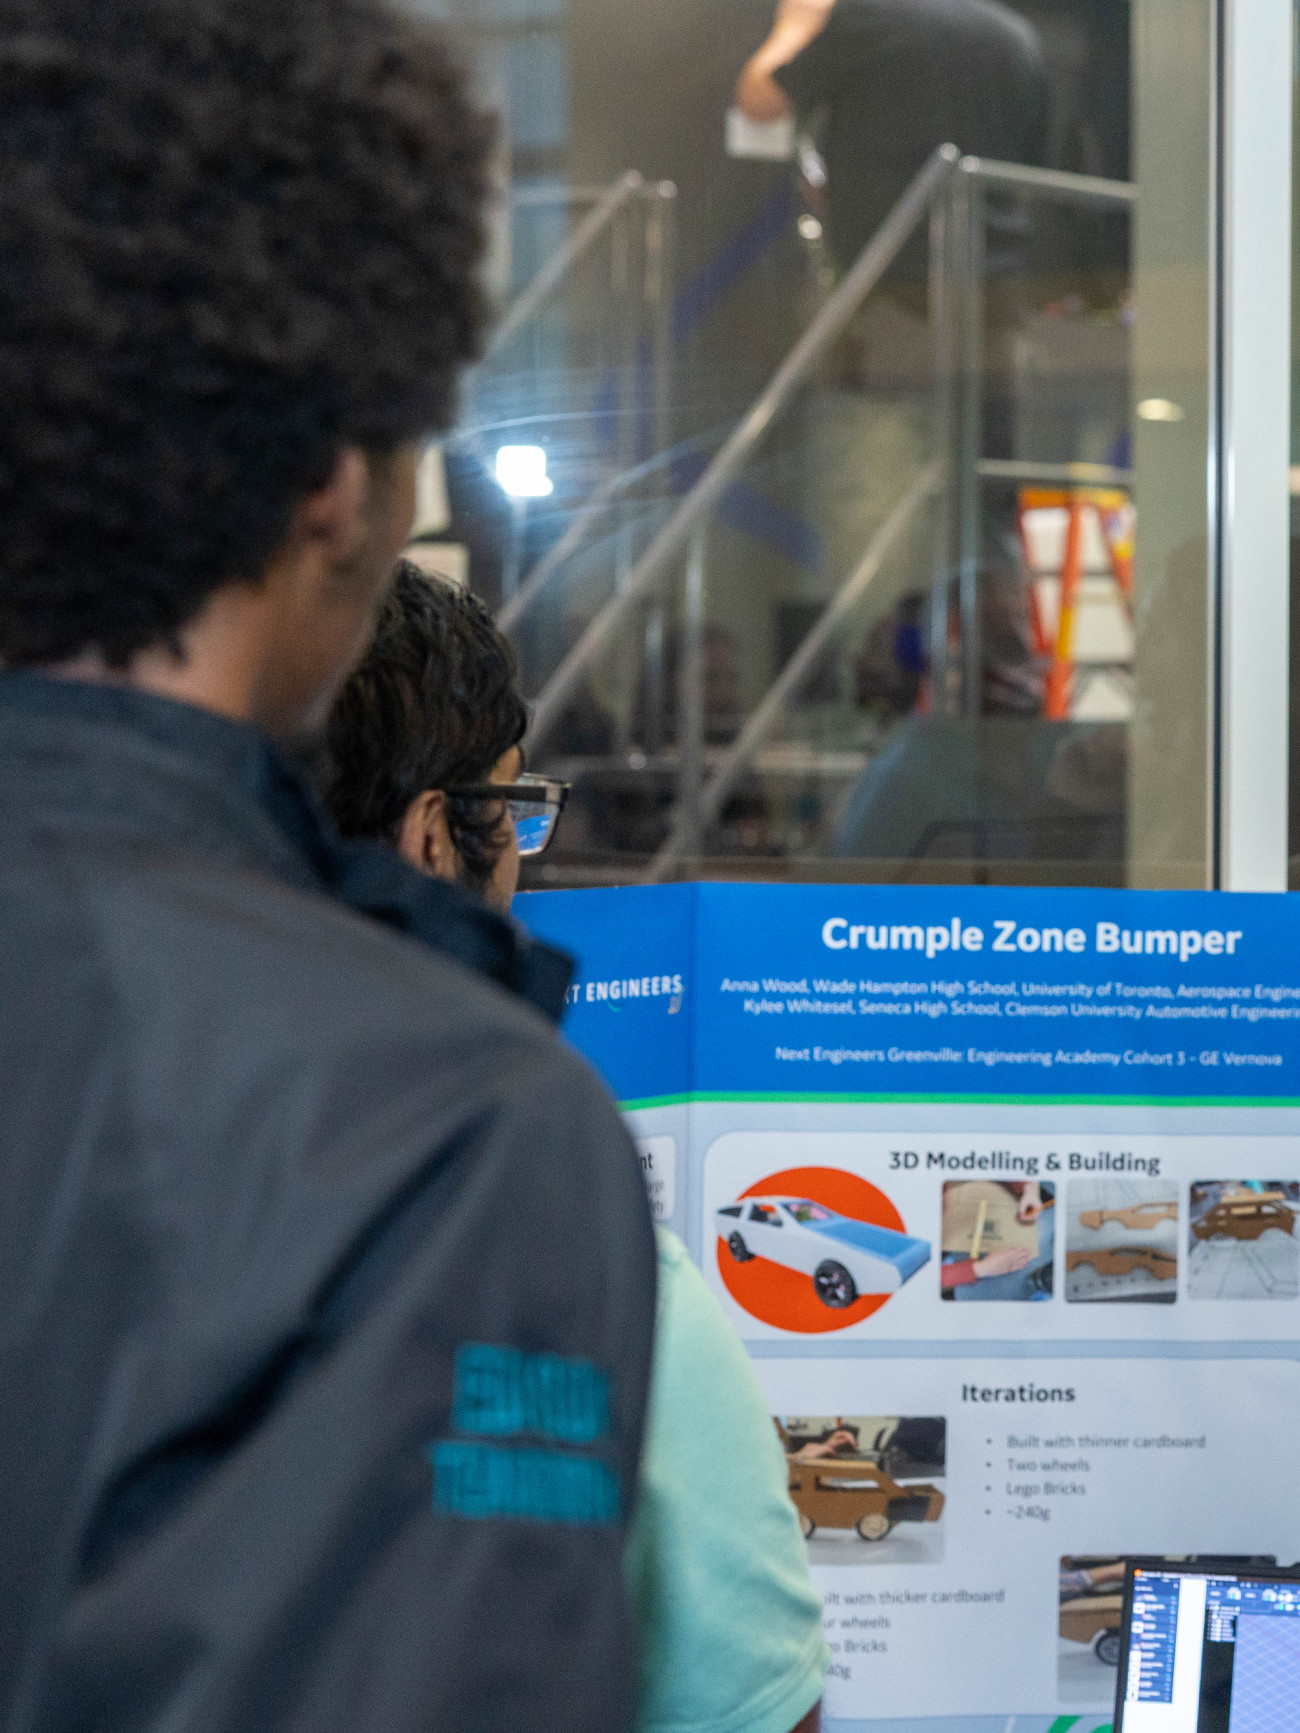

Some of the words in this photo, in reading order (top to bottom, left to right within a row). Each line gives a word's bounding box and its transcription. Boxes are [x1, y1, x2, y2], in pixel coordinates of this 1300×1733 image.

[821, 916, 985, 959] Crumple
[991, 919, 1087, 953] Zone
[1095, 921, 1243, 963] Bumper
[585, 974, 682, 1002] ENGINEERS
[720, 978, 760, 993] Anna
[761, 978, 811, 994] Wood,
[812, 978, 857, 994] Wade
[858, 979, 929, 997] Hampton
[930, 979, 965, 998] High
[966, 979, 1020, 997] School,
[1021, 981, 1094, 1000] University
[1096, 981, 1113, 997] of
[1114, 981, 1175, 999] Toronto,
[1176, 983, 1252, 1001] Aerospace
[743, 998, 785, 1015] Kylee
[858, 998, 912, 1015] Seneca
[913, 999, 949, 1019] High
[950, 1000, 1003, 1017] School,
[1004, 1001, 1069, 1017] Clemson
[1070, 1003, 1143, 1021] University
[1144, 1004, 1229, 1019] Automotive
[775, 1046, 811, 1062] Next
[812, 1046, 886, 1066] Engineers
[966, 1047, 1053, 1068] Engineering
[1054, 1048, 1122, 1066] Academy
[1122, 1049, 1174, 1066] Cohort
[1176, 1050, 1186, 1066] 3
[1199, 1050, 1220, 1066] GE
[1222, 1051, 1284, 1066] Vernova
[889, 1151, 920, 1171] 3D
[925, 1150, 1040, 1177] Modelling
[1044, 1152, 1062, 1172] &
[1068, 1151, 1161, 1178] Building
[961, 1383, 1076, 1403] Iterations
[1006, 1434, 1041, 1449] Built
[1042, 1434, 1076, 1449] with
[1077, 1434, 1131, 1449] thinner
[1132, 1434, 1208, 1450] cardboard
[1007, 1457, 1039, 1473] Two
[1040, 1457, 1092, 1473] wheels
[1005, 1481, 1042, 1499] Lego
[1043, 1480, 1087, 1496] Bricks
[842, 1591, 877, 1606] with
[878, 1588, 929, 1605] thicker
[930, 1587, 1006, 1604] cardboard
[839, 1615, 891, 1630] wheels
[843, 1638, 890, 1655] Bricks
